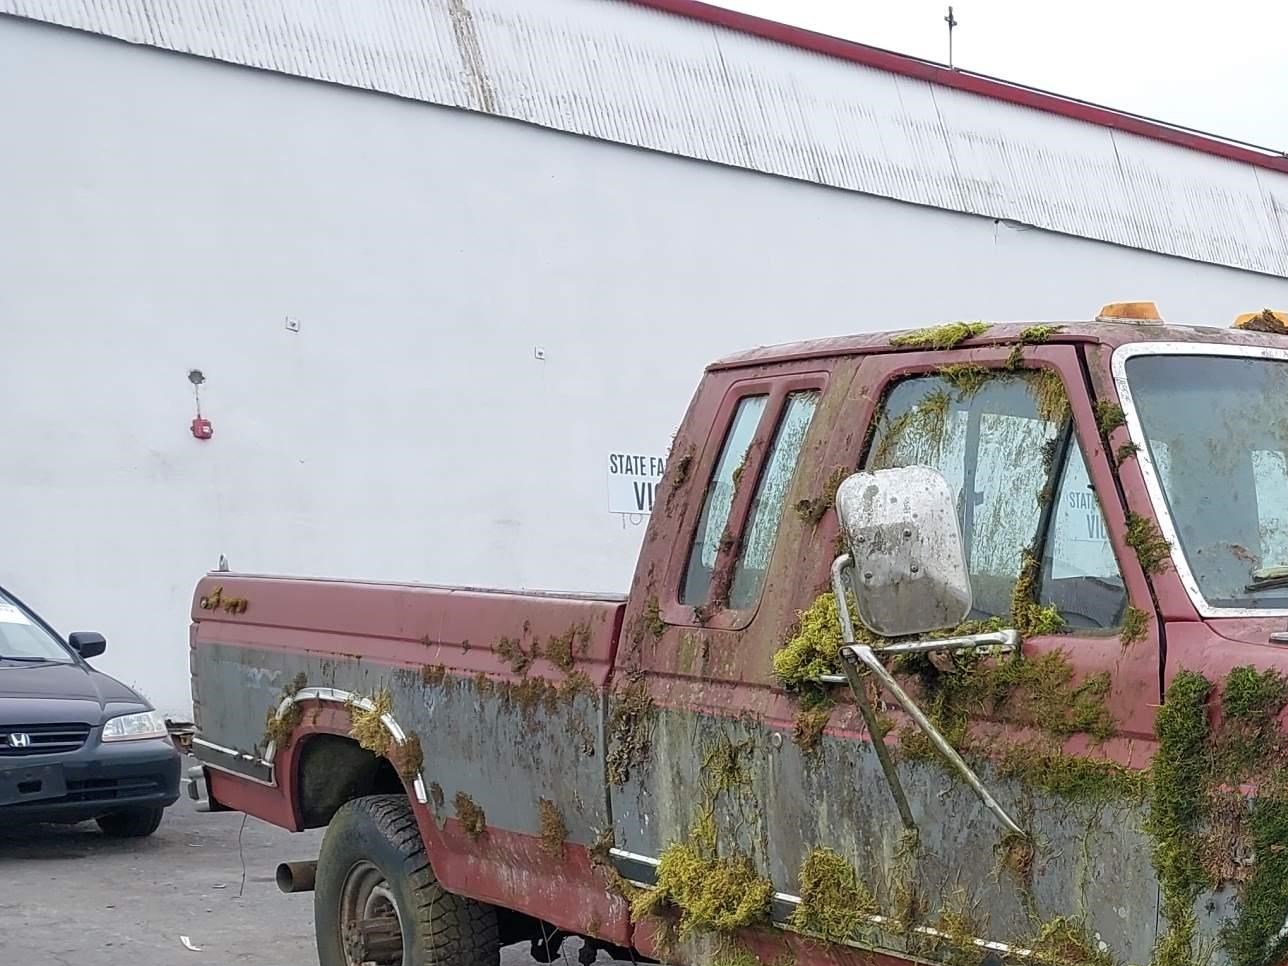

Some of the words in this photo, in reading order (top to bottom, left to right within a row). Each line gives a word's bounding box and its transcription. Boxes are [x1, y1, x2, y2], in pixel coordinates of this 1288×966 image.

[610, 454, 647, 476] STATE
[650, 456, 666, 477] FA
[633, 481, 658, 511] VI
